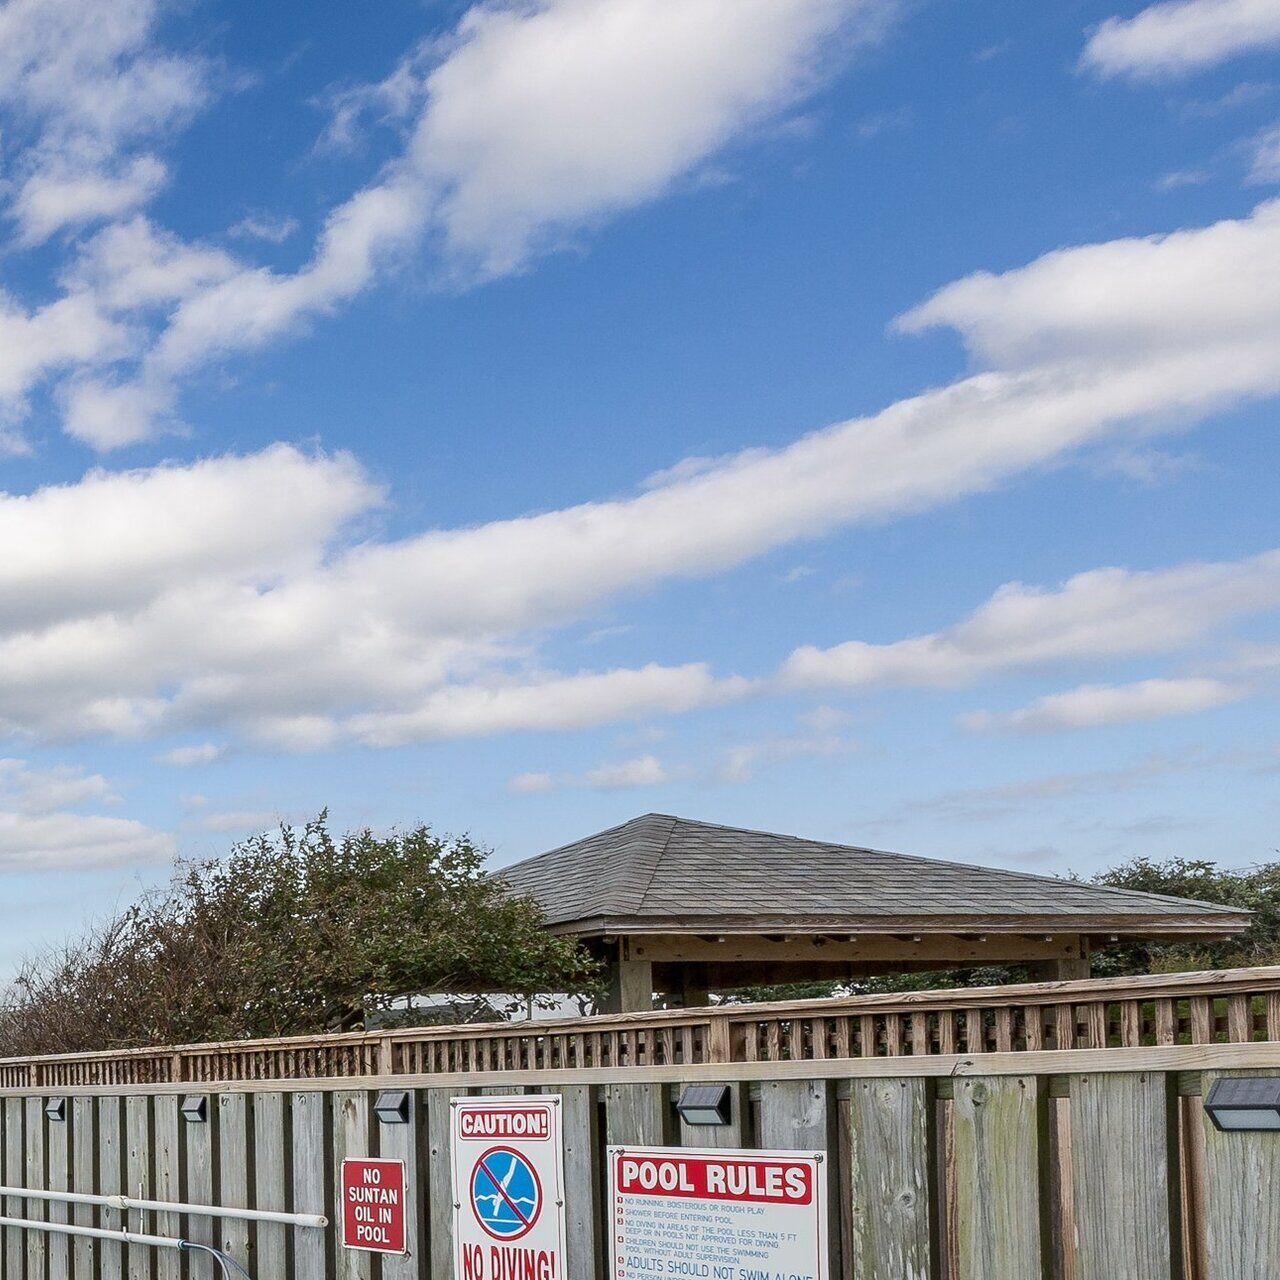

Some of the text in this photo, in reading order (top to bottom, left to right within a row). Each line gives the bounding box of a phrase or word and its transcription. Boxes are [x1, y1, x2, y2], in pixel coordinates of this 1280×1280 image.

[462, 1114, 548, 1134] CAUTION!
[363, 1168, 380, 1184] NO
[623, 1161, 806, 1198] POOL RULES
[349, 1187, 397, 1204] SUNTAN
[355, 1207, 392, 1224] OIL IN
[654, 1211, 677, 1220] BEFORE
[681, 1214, 712, 1222] ENTERING
[667, 1201, 707, 1210] BOISTEROUS
[721, 1205, 744, 1213] ROUGH
[747, 1207, 764, 1215] PLAY
[357, 1225, 390, 1243] POOL
[702, 1235, 736, 1244] APPROVED
[718, 1228, 735, 1236] POOL
[759, 1232, 778, 1240] THAN
[626, 1238, 655, 1246] CHILDREN
[659, 1241, 683, 1249] SHOULD
[733, 1249, 769, 1259] SWIMMING
[644, 1248, 670, 1256] WITHOUT
[674, 1251, 694, 1259] ADULT
[627, 1257, 663, 1271] ADULTS
[668, 1261, 709, 1277] SHOULD
[714, 1266, 734, 1280] NOT
